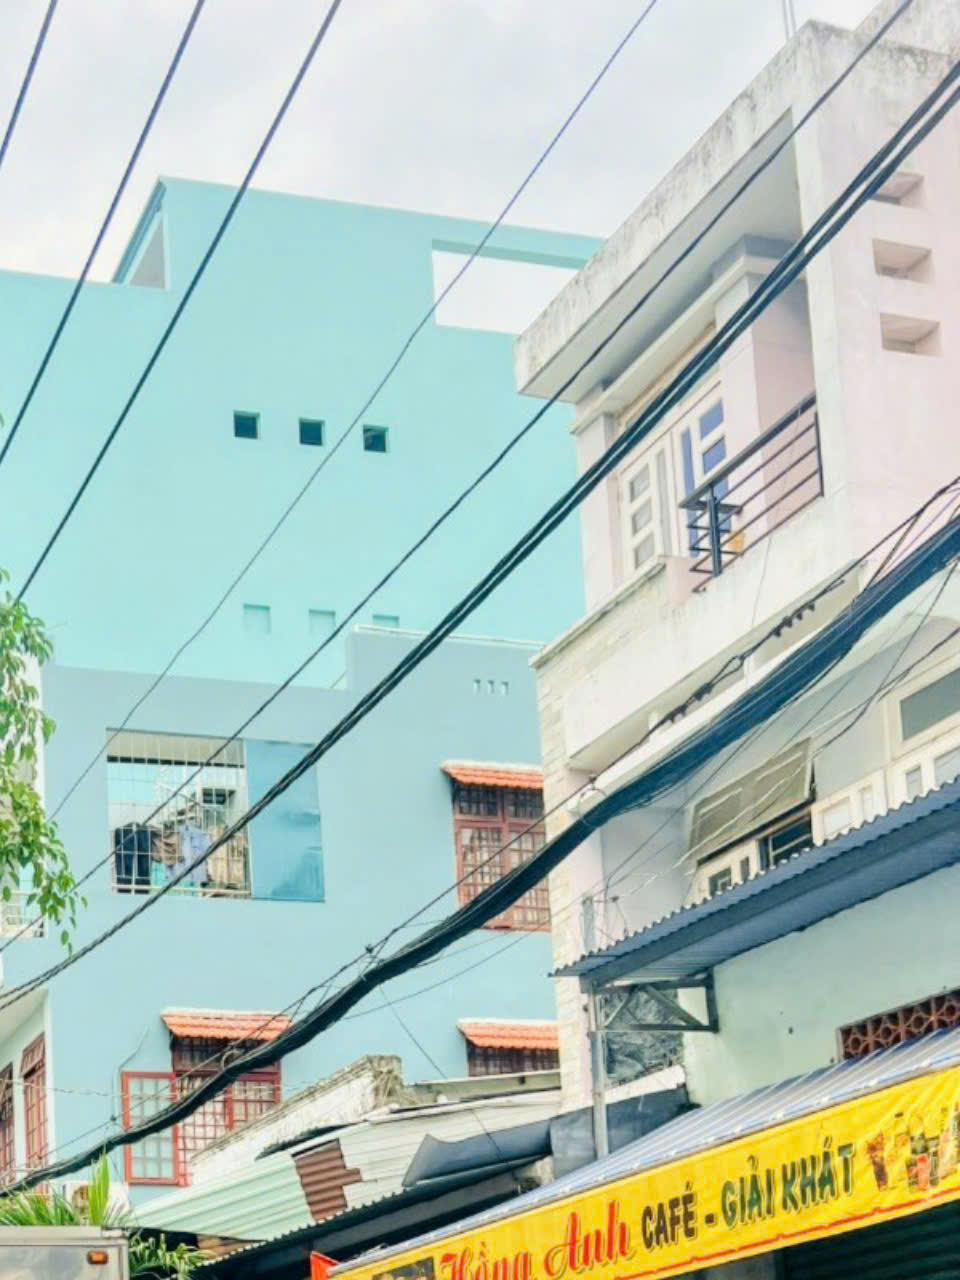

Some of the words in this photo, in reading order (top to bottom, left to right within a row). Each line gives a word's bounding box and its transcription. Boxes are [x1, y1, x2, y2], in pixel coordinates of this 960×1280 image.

[544, 1200, 632, 1278] Anh
[641, 1181, 697, 1250] CAFÉ
[721, 1155, 774, 1228] GIẢI
[781, 1136, 855, 1211] KHÁT
